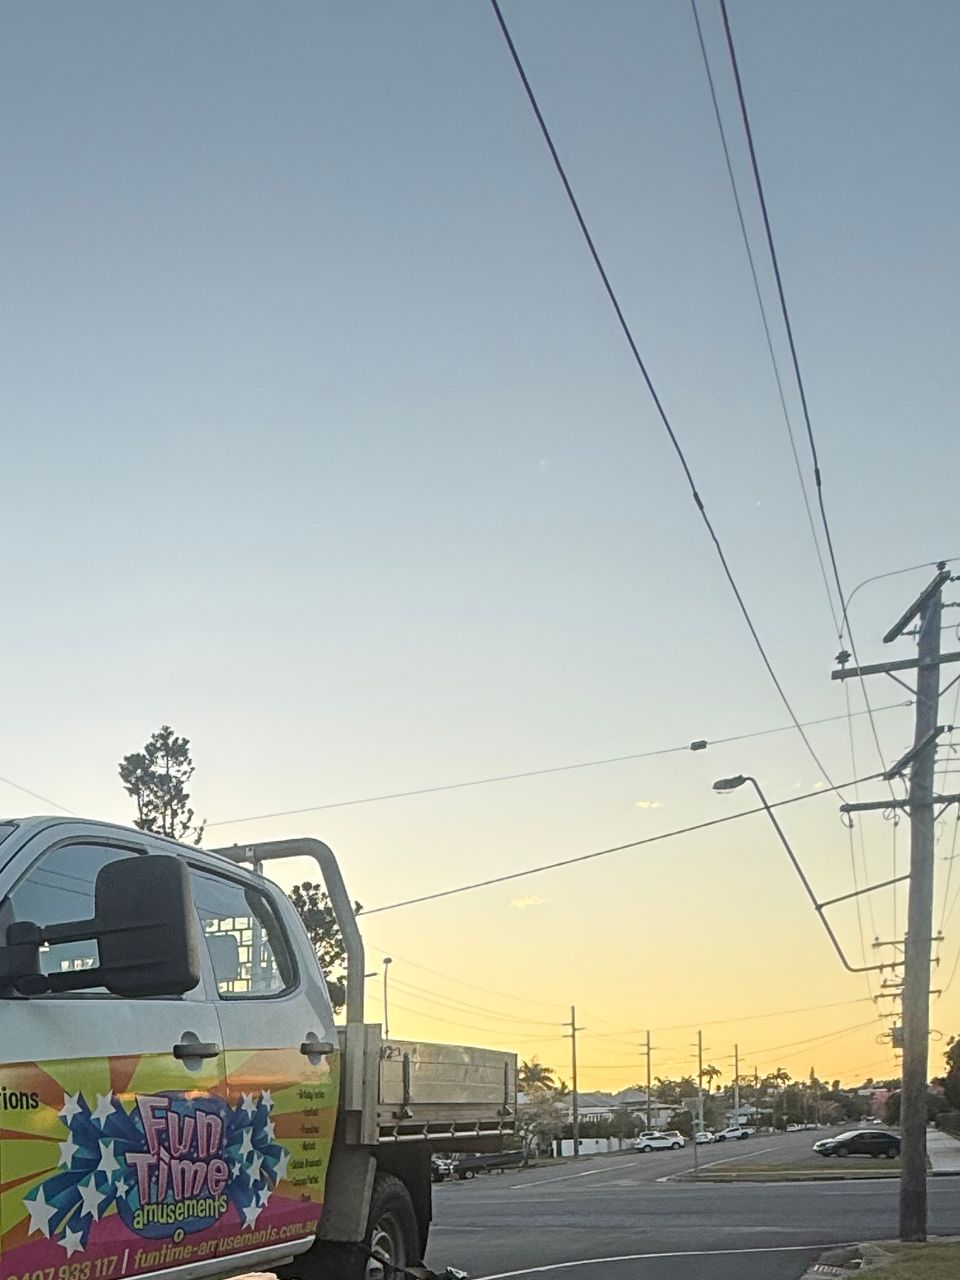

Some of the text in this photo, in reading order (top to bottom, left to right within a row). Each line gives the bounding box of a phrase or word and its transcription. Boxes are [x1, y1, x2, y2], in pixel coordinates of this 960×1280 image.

[135, 1094, 223, 1158] Fun
[125, 1145, 229, 1206] Time
[133, 1195, 228, 1229] amusements
[95, 1254, 118, 1278] 117
[134, 1220, 317, 1269] funtime-amusements.com.au
